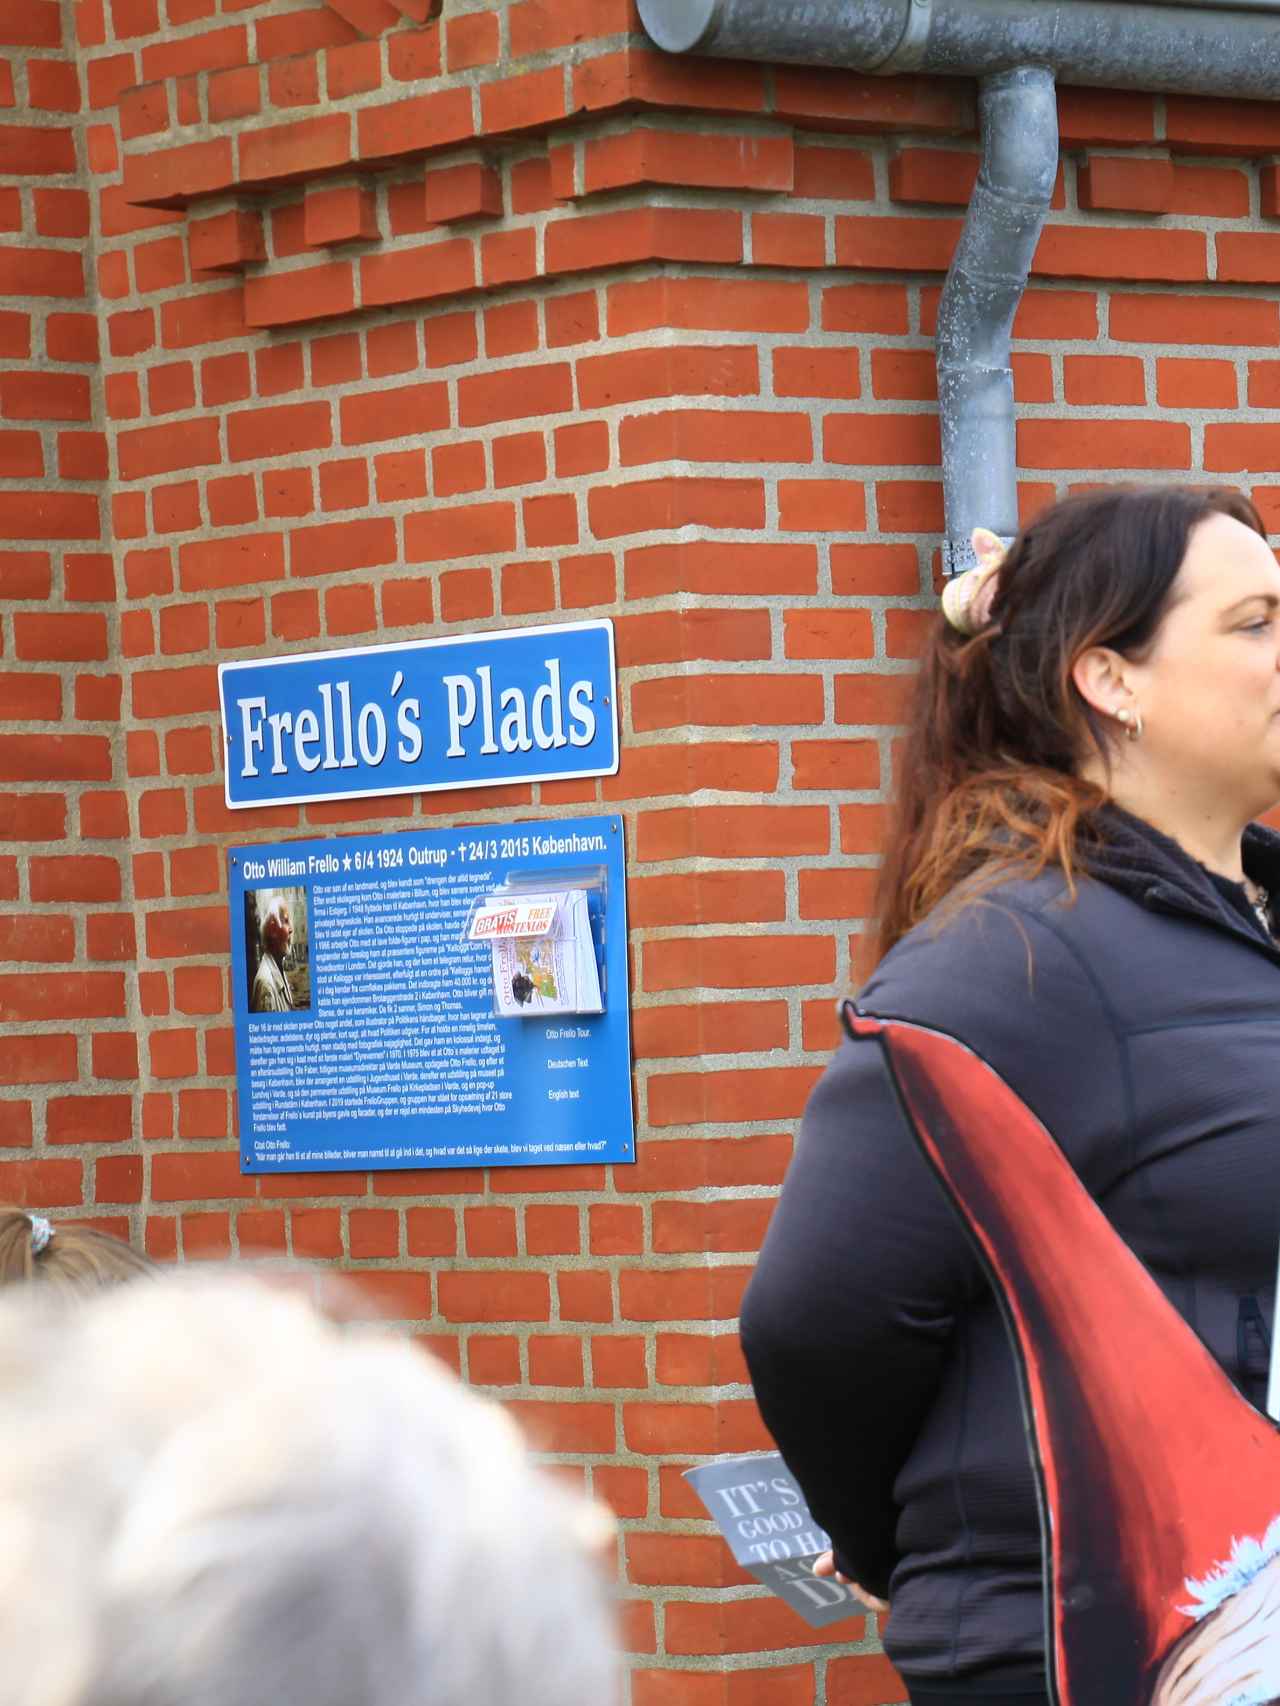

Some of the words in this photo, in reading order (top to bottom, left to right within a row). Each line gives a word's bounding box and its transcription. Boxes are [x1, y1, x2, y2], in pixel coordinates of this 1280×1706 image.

[442, 658, 597, 758] Plads
[243, 859, 265, 879] Otto
[267, 856, 305, 877] William
[308, 853, 339, 874] Frello
[376, 848, 403, 868] 1924
[408, 844, 447, 869] Outrup
[500, 838, 529, 859] 2015
[531, 831, 607, 856] København.
[714, 1477, 800, 1519] IT'S
[737, 1509, 804, 1540] GOOD
[749, 1538, 792, 1564] TO
